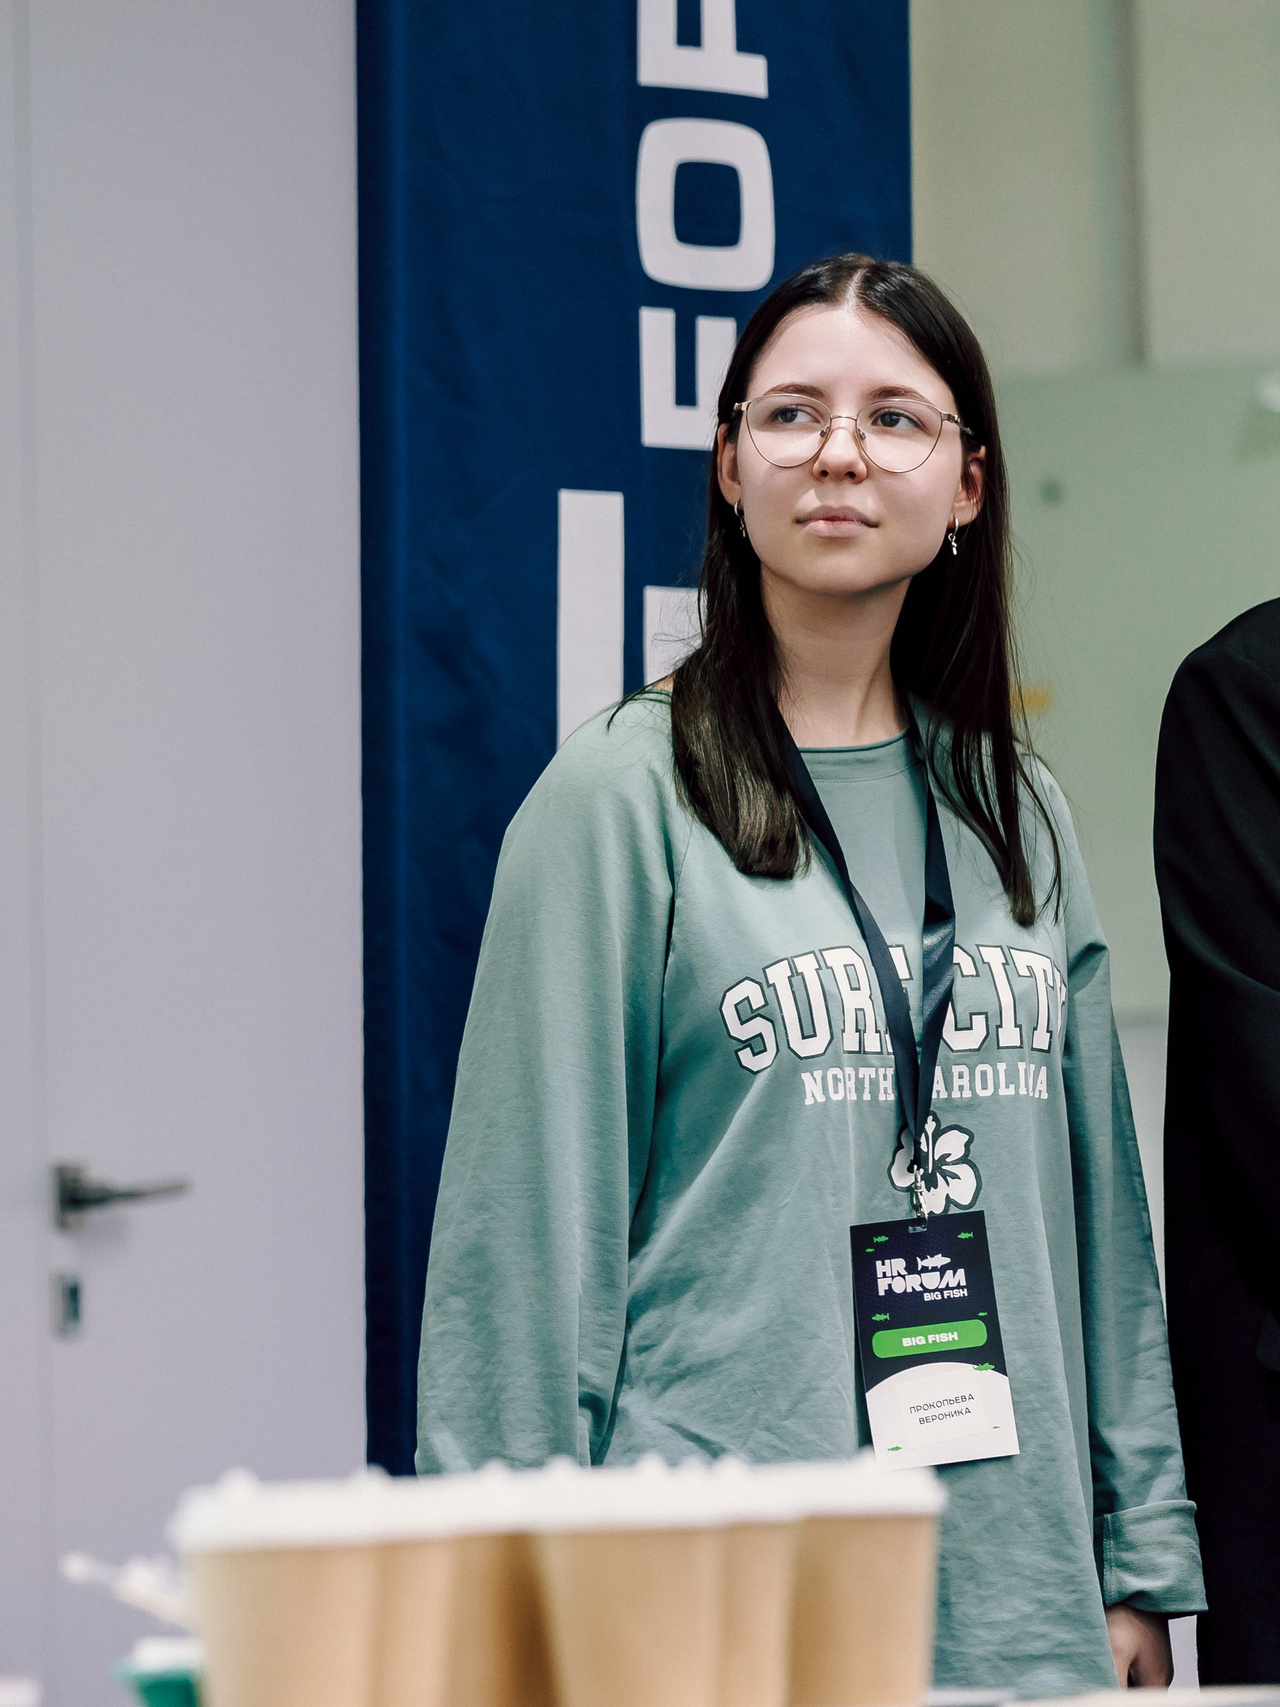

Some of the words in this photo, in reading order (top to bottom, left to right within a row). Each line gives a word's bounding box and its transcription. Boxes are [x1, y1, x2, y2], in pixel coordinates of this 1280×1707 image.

[801, 1066, 895, 1106] NORTH
[931, 1061, 1049, 1100] AROLINA
[875, 1258, 908, 1278] HR
[877, 1268, 967, 1296] FORUM
[923, 1292, 942, 1302] BIG
[943, 1288, 968, 1300] FISH
[901, 1335, 926, 1347] BIG
[927, 1331, 959, 1344] FISH
[909, 1393, 975, 1414] ПРОКОПЬЕВА
[918, 1407, 972, 1425] ВЕРОНИКА
